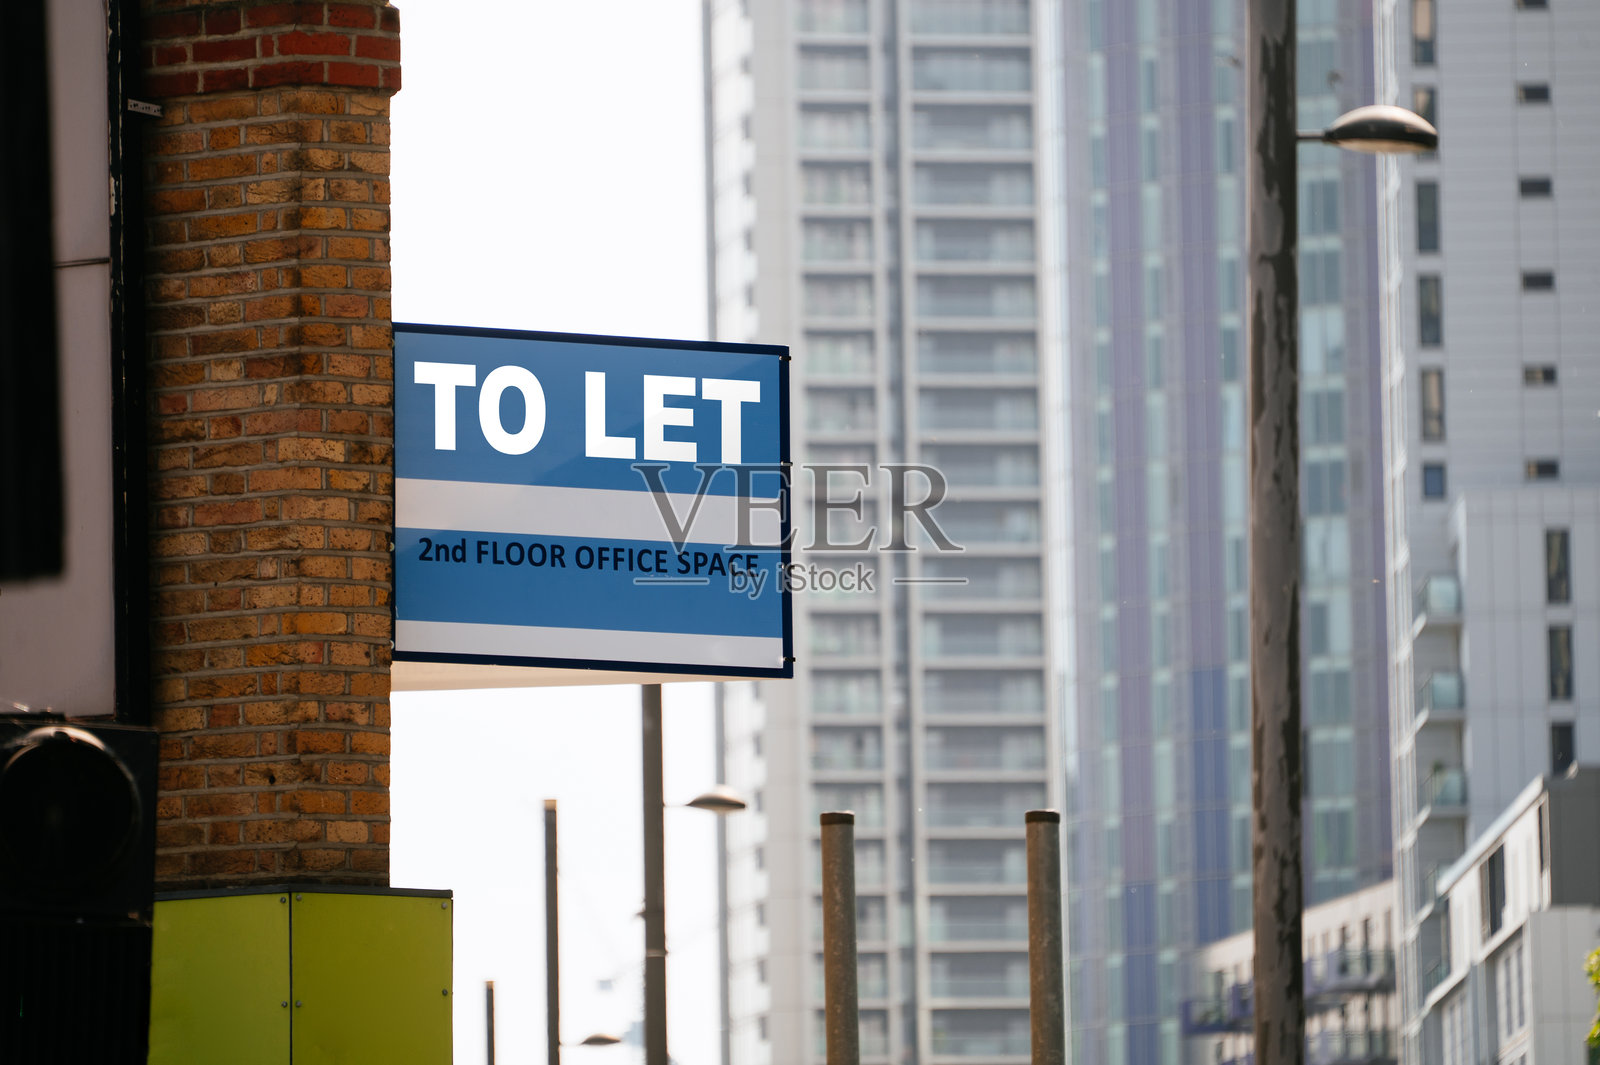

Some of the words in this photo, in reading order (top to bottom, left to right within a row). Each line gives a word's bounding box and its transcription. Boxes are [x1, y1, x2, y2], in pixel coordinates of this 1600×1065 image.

[414, 361, 546, 455] TO
[585, 371, 761, 465] LET
[418, 537, 467, 563] 2nd
[476, 540, 566, 568] FLOOR
[575, 544, 668, 573] OFFICE
[678, 549, 759, 579] SPACE
